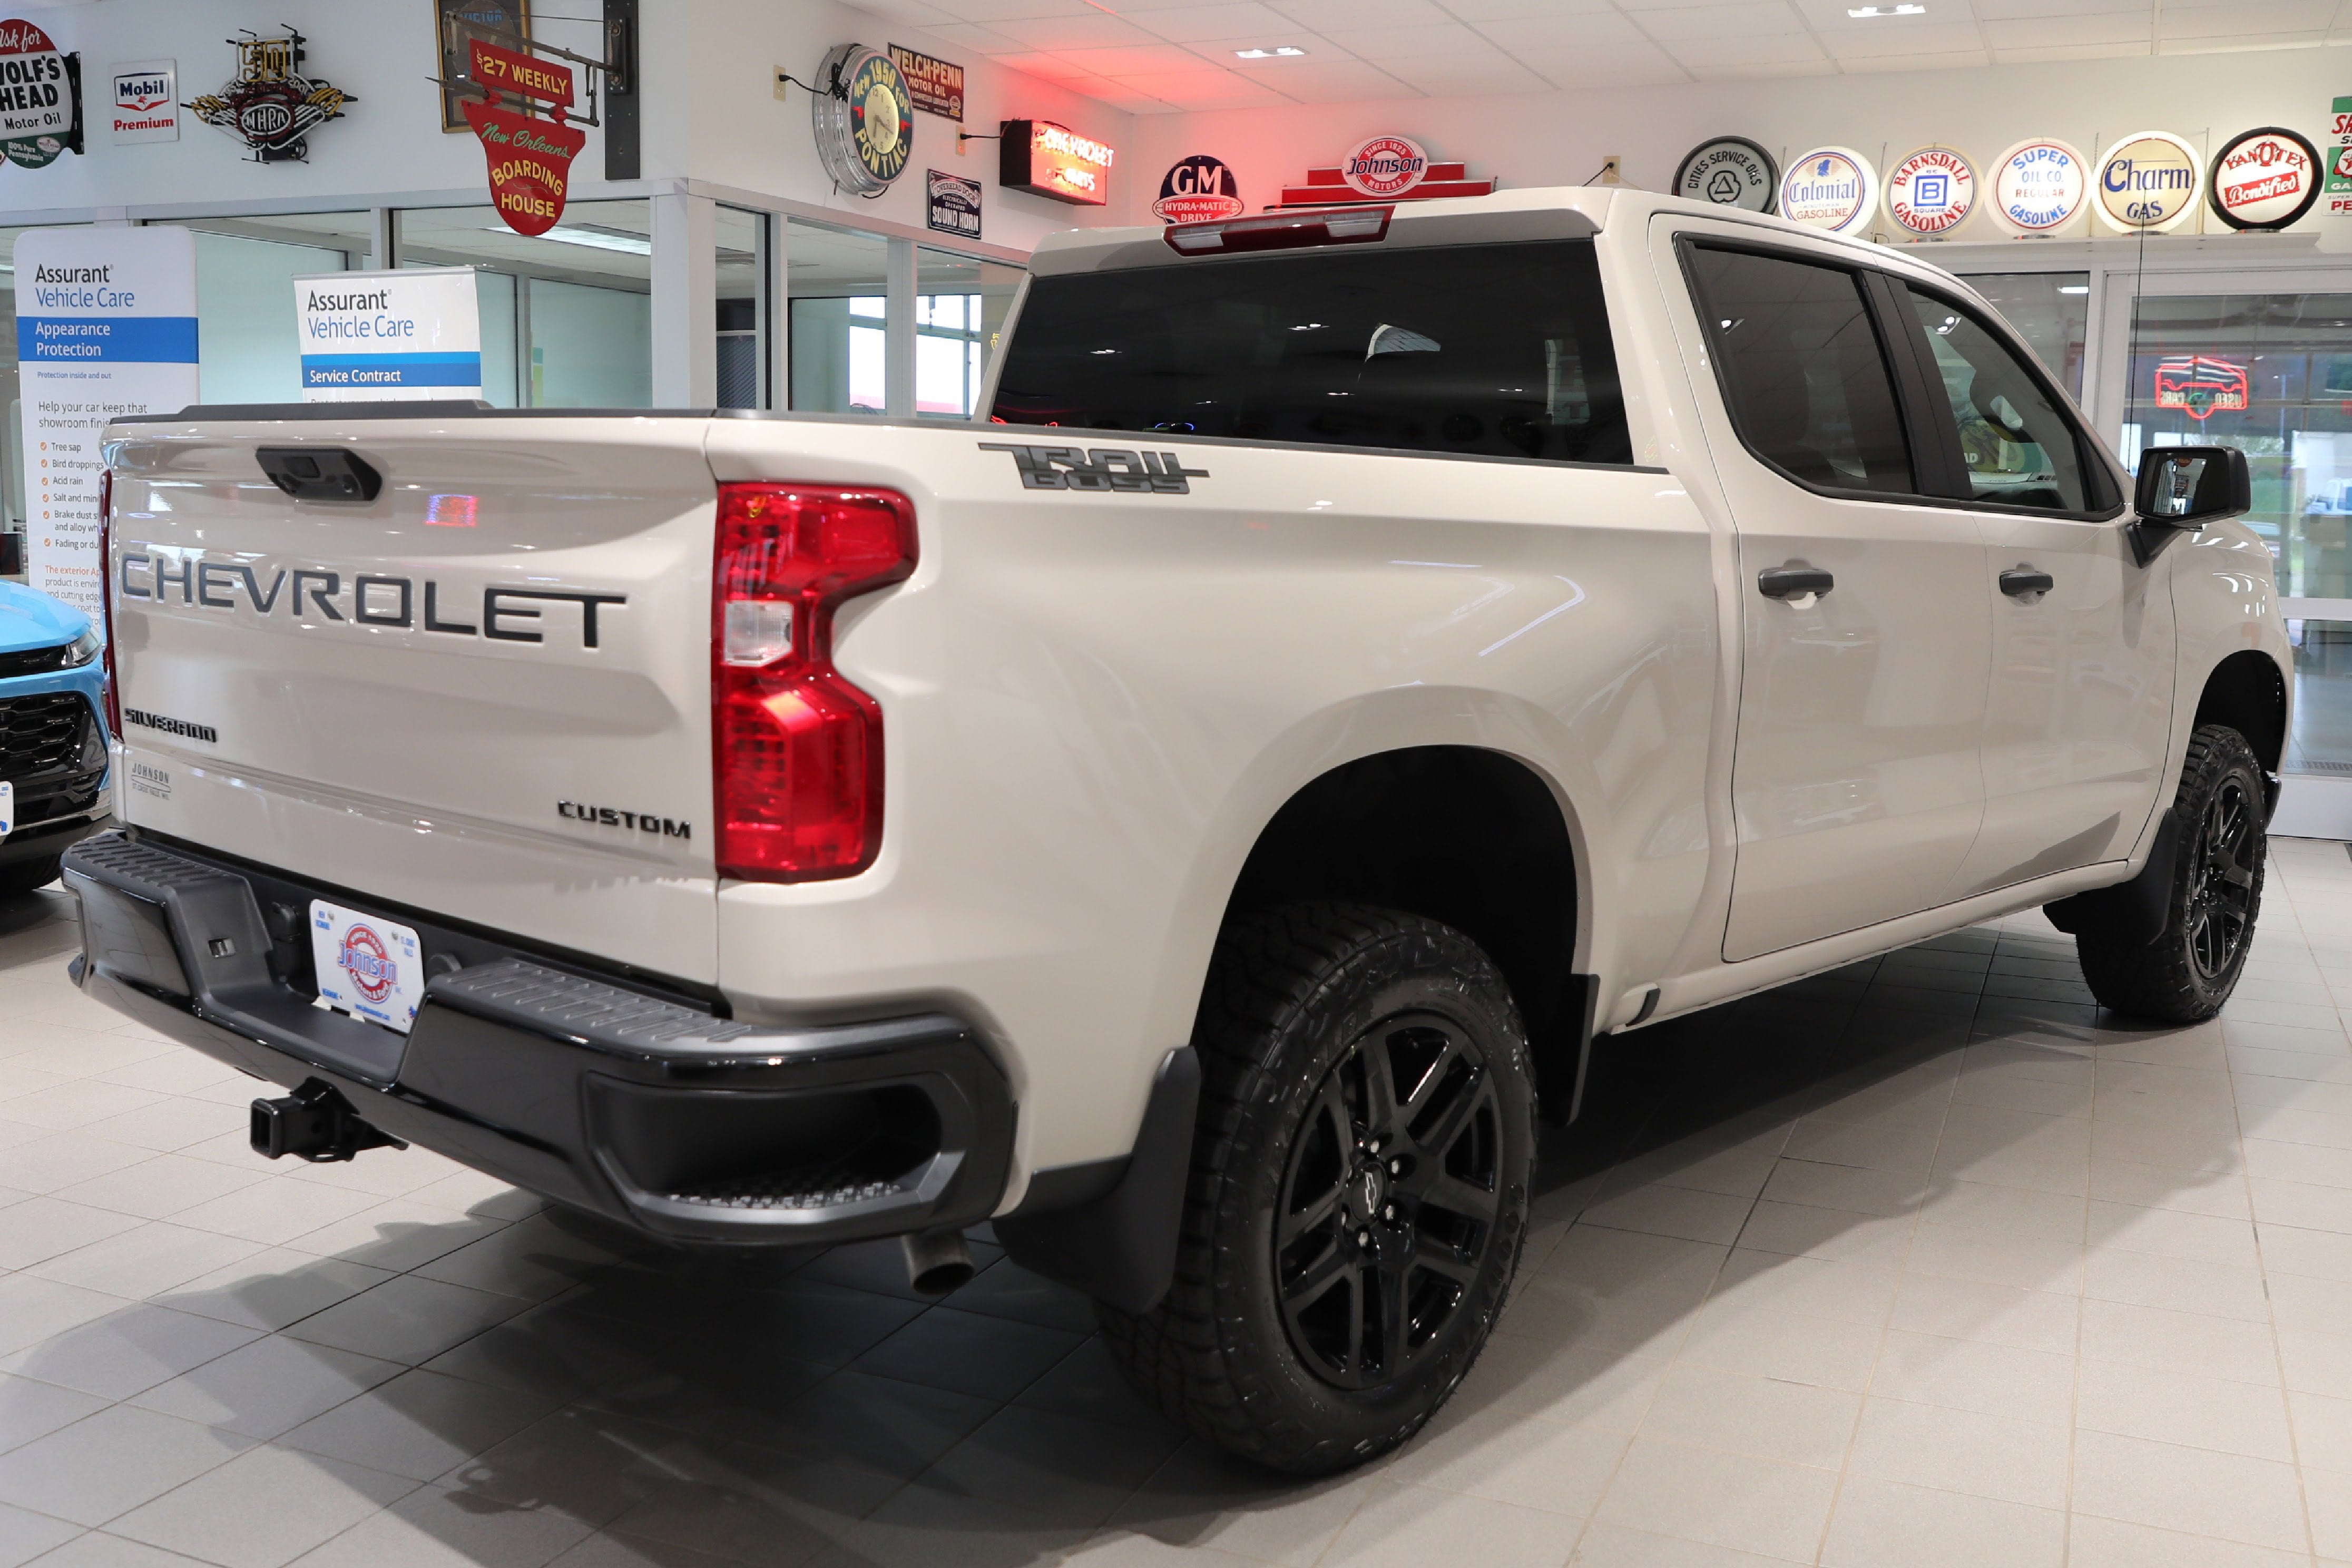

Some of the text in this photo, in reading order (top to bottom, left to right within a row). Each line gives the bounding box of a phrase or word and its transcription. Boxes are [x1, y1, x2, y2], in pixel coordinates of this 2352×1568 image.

[21, 25, 41, 52] for
[0, 55, 61, 85] OLF'S
[242, 40, 287, 82] 50
[476, 48, 567, 95] $27 WEEKLY
[120, 80, 164, 96] Mobil
[855, 74, 870, 99] NEW
[870, 59, 895, 90] 1950
[896, 86, 910, 114] FOR
[908, 75, 946, 97] MOTOR OIL
[0, 84, 58, 111] HEAD
[4, 112, 62, 130] Motor Oil
[114, 117, 174, 131] Premium
[247, 108, 287, 131] NHRA
[481, 123, 571, 159] New Orleans
[1045, 128, 1114, 167] CHEVROLET
[1365, 142, 1407, 156] SINCE 1925
[2340, 135, 2352, 144] S
[855, 127, 907, 177] PONTIAC
[2013, 149, 2069, 170] SUPER
[1347, 158, 1424, 175] Johnson
[1688, 151, 1762, 189] CITIES SERVICE OILS
[1894, 153, 1970, 187] BARNSDALL
[2104, 159, 2190, 192] Charm
[492, 160, 564, 196] BOARDING
[1172, 165, 1223, 195] GM
[1368, 179, 1403, 190] MOTORS
[2022, 171, 2064, 183] OIL CO.
[1789, 178, 1856, 202] Colonial
[1922, 183, 1941, 199] B
[2016, 189, 2064, 198] REGULAR
[2229, 174, 2297, 204] Bondified
[501, 193, 555, 218] HOUSE
[1797, 208, 1848, 219] GASOLINE
[2010, 204, 2067, 224] GASOLINE
[2127, 200, 2163, 219] GAS
[933, 205, 957, 227] SOUND
[959, 211, 978, 232] HORN
[1181, 213, 1213, 222] DRIVE
[1894, 201, 1966, 231] GASOLINE
[35, 287, 135, 307] Vehicle Care
[35, 320, 111, 339] Appearance
[308, 315, 415, 339] Vehicle Care
[36, 342, 102, 356] Protection
[310, 369, 401, 383] Service Contract
[38, 401, 60, 414] Help
[62, 404, 83, 414] your
[103, 401, 125, 415] keep
[128, 402, 148, 413] that
[39, 417, 88, 428] showroom
[51, 442, 81, 454] Tree sap
[53, 459, 104, 471] Bird droppings
[977, 443, 1210, 477] TRAIL
[53, 476, 68, 485] Acid
[1020, 469, 1190, 494] BOSS
[68, 494, 81, 502] and
[83, 494, 99, 503] min
[76, 511, 91, 519] dust
[70, 523, 86, 534] alloy
[56, 540, 79, 550] Fading
[45, 565, 60, 574] The
[61, 566, 90, 575] exterior
[45, 578, 72, 587] product
[61, 591, 84, 602] cutting
[123, 553, 626, 648] CHEVROLET
[124, 708, 218, 743] SILVERADO
[132, 762, 169, 783] JOHNSON
[558, 800, 691, 839] CUSTOM
[339, 940, 397, 984] Johnson
